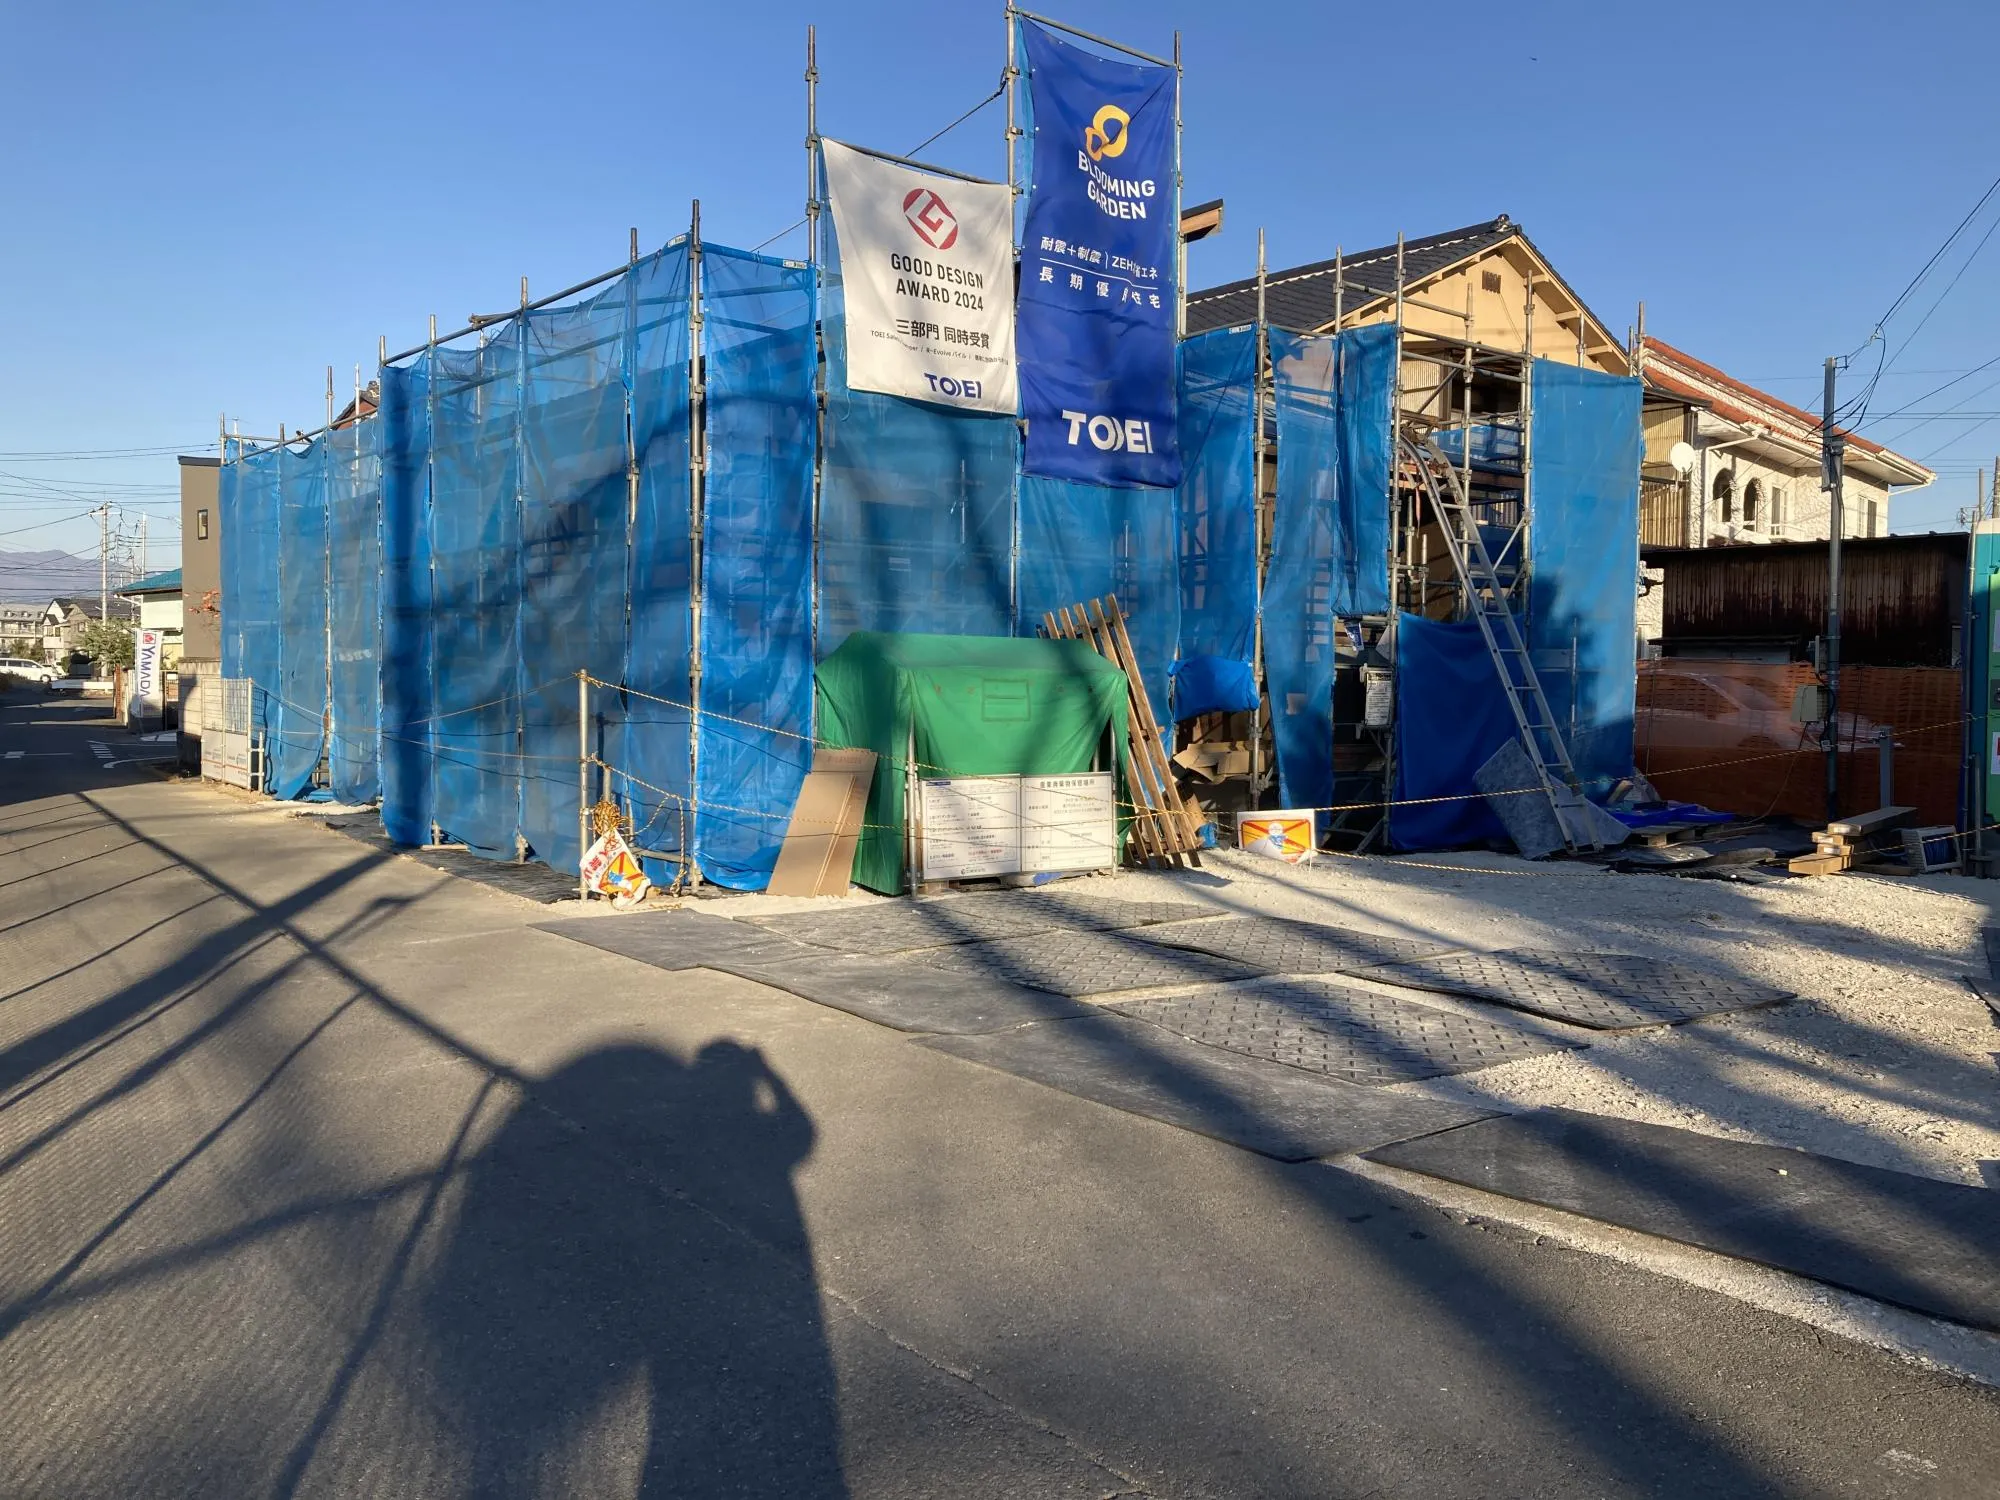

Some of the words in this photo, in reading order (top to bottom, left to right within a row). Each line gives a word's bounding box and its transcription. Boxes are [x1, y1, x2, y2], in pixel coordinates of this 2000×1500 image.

[1078, 149, 1156, 198] BLOOMING
[1087, 179, 1147, 219] GARDEN
[891, 253, 932, 276] GOOD
[937, 264, 984, 289] DESIGN
[896, 278, 950, 303] AWARD
[954, 291, 984, 311] 2024
[895, 318, 940, 340] 三部門
[944, 325, 990, 350] 同時受賞
[139, 645, 156, 697] YAMADA
